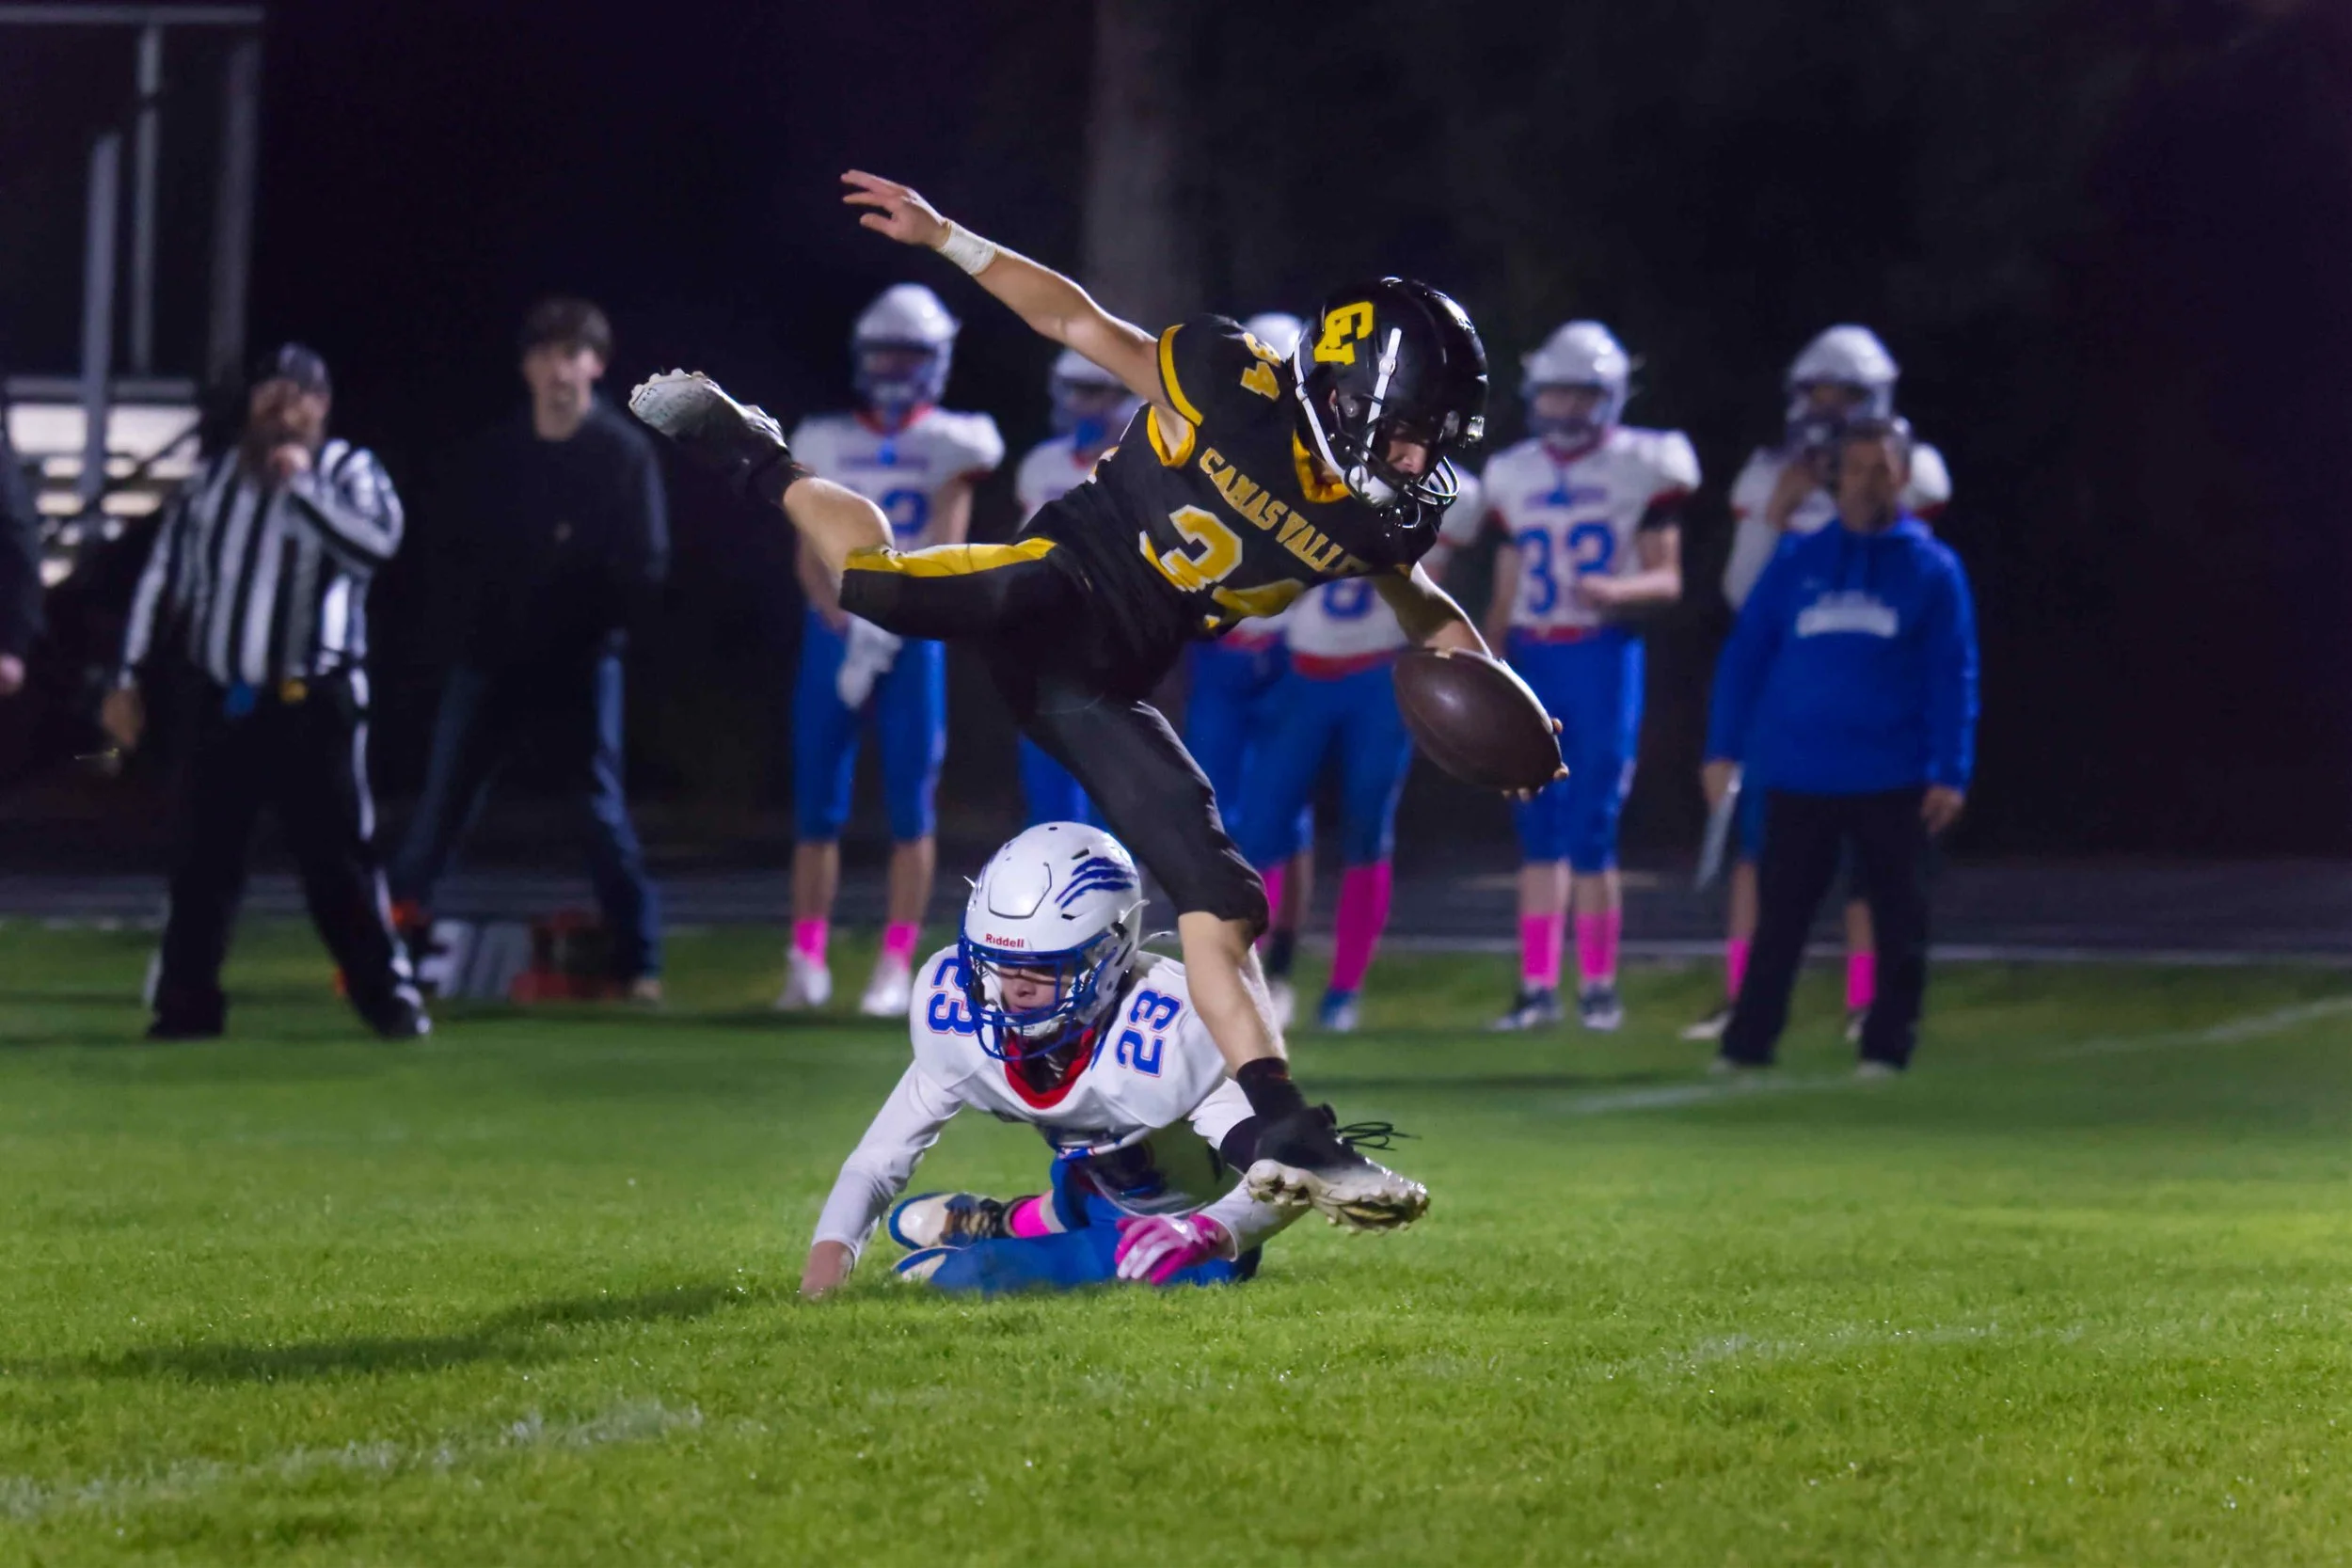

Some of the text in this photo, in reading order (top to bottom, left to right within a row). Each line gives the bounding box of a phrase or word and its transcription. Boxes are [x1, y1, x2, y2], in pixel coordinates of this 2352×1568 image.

[1199, 447, 1289, 531] CAMAS
[1516, 521, 1616, 616] 32
[985, 932, 1025, 948] Riddell
[1115, 988, 1184, 1078] 23
